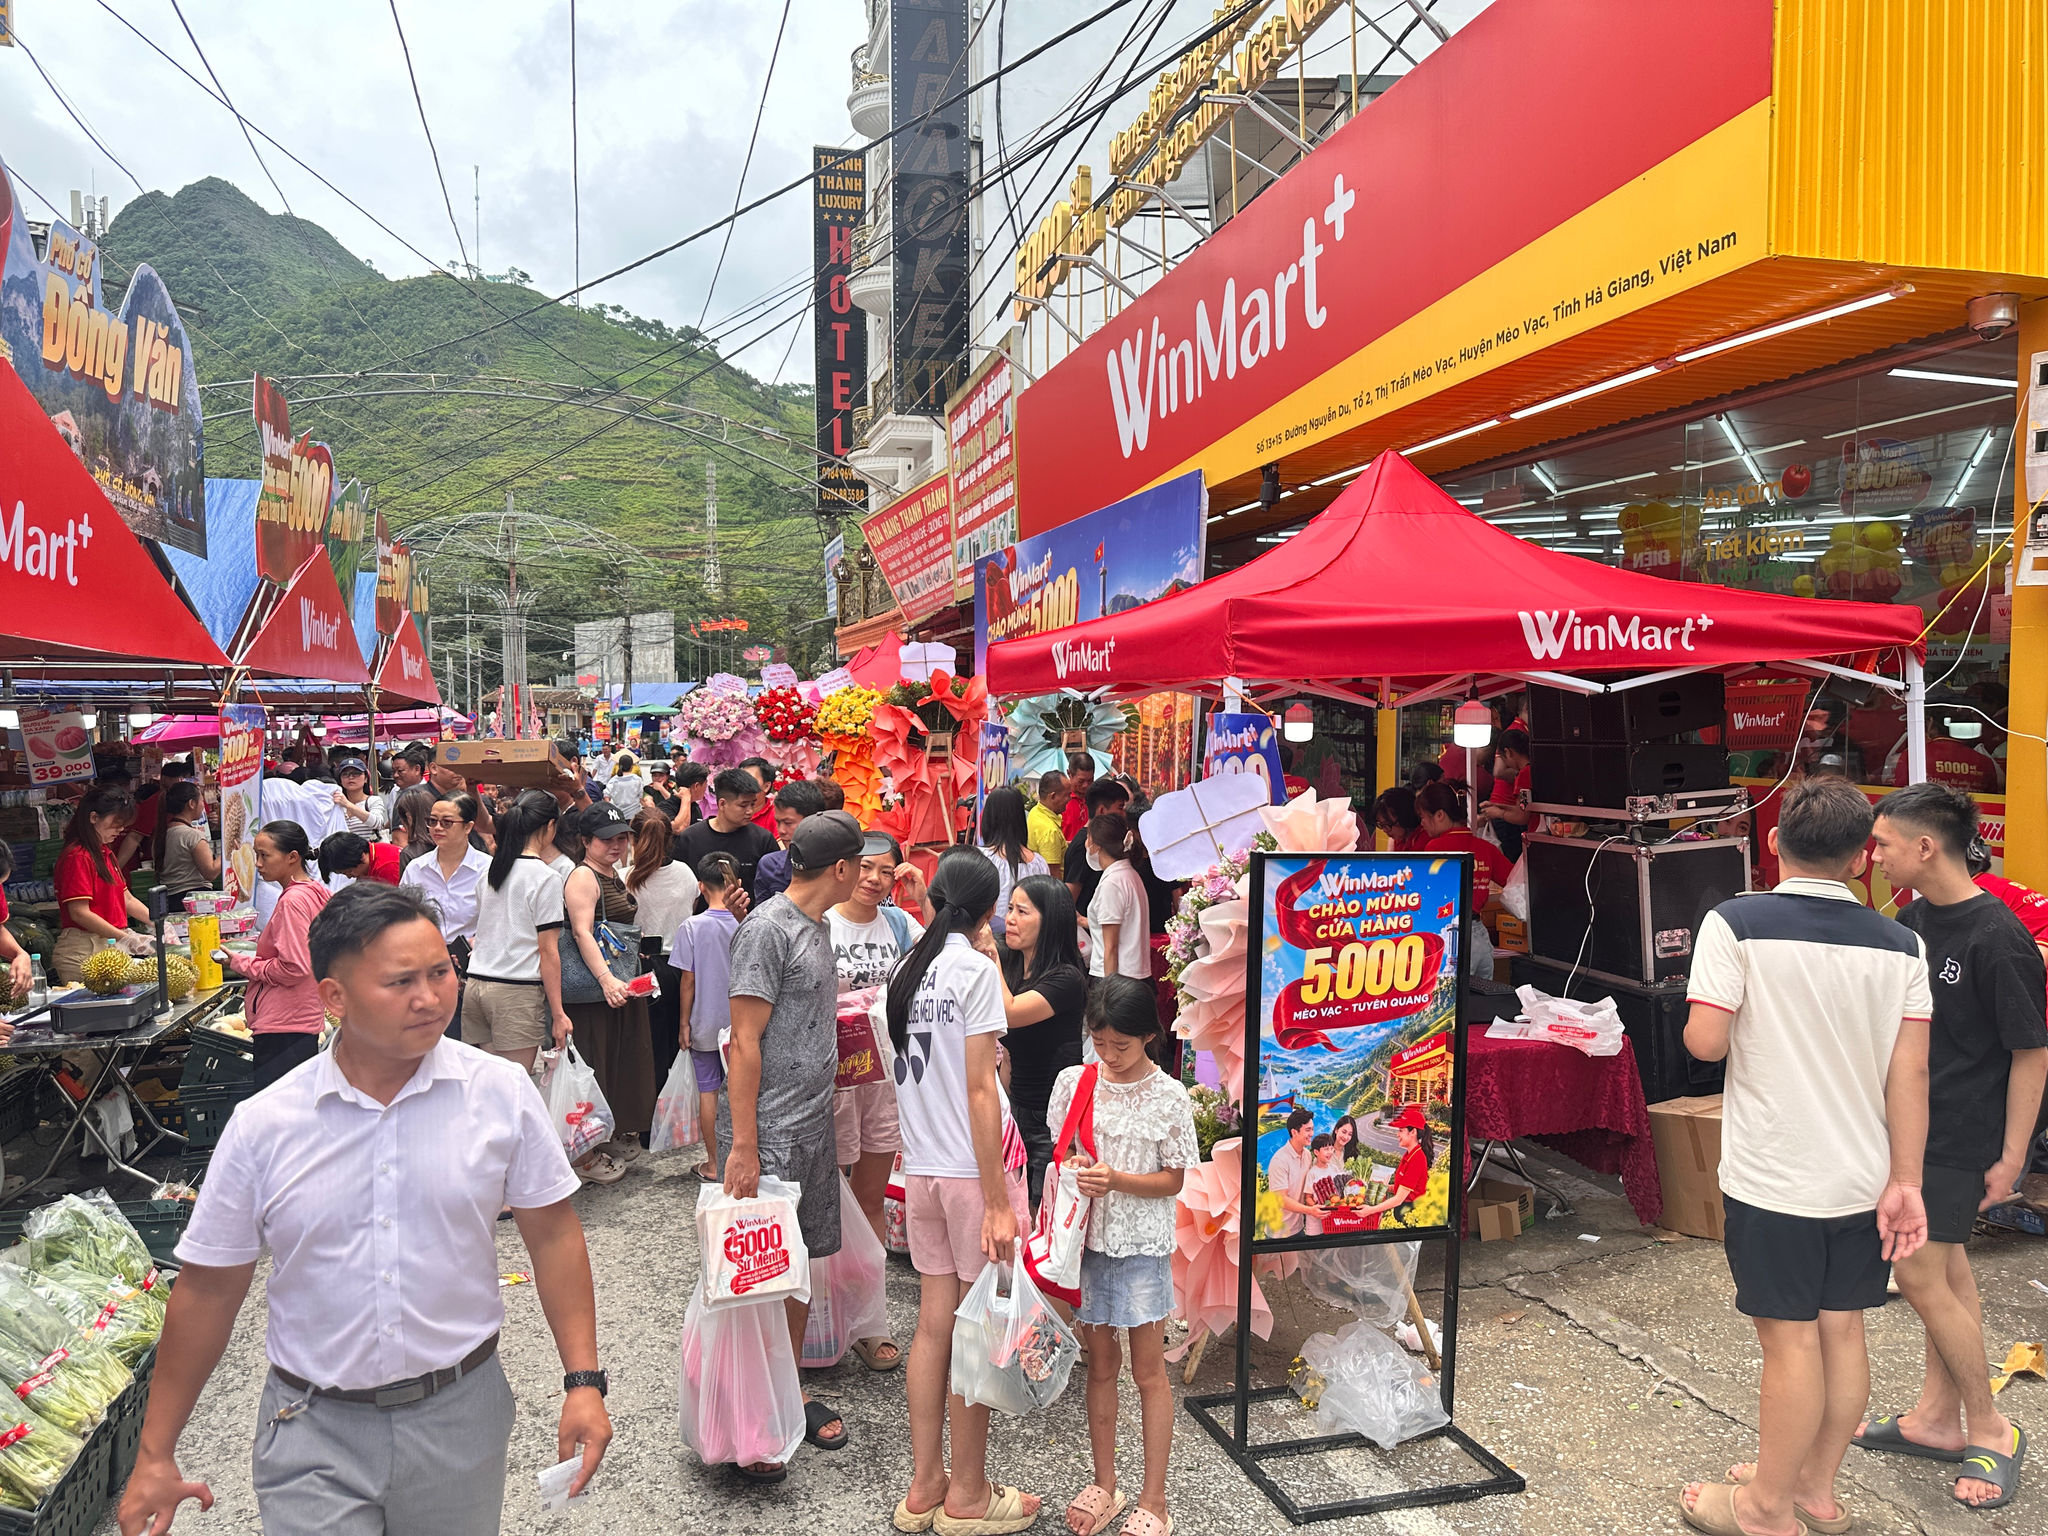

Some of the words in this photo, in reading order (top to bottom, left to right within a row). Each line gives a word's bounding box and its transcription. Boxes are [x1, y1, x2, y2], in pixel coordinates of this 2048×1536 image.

[819, 172, 862, 192] THÀNH
[819, 194, 862, 210] LUXURY
[43, 272, 129, 396] Đồng
[134, 314, 182, 408] Văn
[828, 225, 852, 456] HOTEL
[1256, 437, 1265, 454] Số
[1266, 432, 1282, 451] 13+15
[1284, 422, 1308, 442] Đường
[1308, 406, 1337, 431] Nguyễn
[1338, 403, 1352, 416] Du,
[1353, 390, 1364, 411] Tổ
[1365, 391, 1374, 405] 2,
[1375, 384, 1389, 401] Thị
[1391, 372, 1411, 394] Trấn
[1412, 365, 1433, 384] Mèo
[1435, 355, 1457, 375] Vạc,
[1459, 336, 1493, 363] Huyện
[1496, 327, 1520, 349] Mèo
[1523, 313, 1550, 335] Vạc,
[1553, 297, 1581, 322] Tỉnh
[1585, 287, 1604, 311] Hà
[1607, 268, 1655, 299] Giang,
[1659, 248, 1692, 276] Việt
[1698, 231, 1738, 260] Nam
[288, 455, 331, 533] 5000
[1703, 487, 1733, 514] An
[880, 513, 902, 541] HÀNG
[899, 500, 924, 530] THANH
[922, 485, 947, 517] THÀNH
[987, 614, 1007, 644] CHÀO
[1007, 602, 1030, 632] MỪNG
[34, 762, 92, 781] 39.000
[1935, 761, 1969, 776] 5000
[1308, 897, 1361, 919] CHÀO
[1366, 891, 1421, 912] MỪNG
[1316, 917, 1354, 939] CỬA
[1359, 914, 1412, 935] HÀNG
[1300, 934, 1425, 1005] 5.000
[935, 999, 955, 1027] VẠC
[1293, 1005, 1318, 1021] MÈO
[1321, 1005, 1342, 1019] VẠC
[1351, 997, 1387, 1013] TUYÊN
[1389, 993, 1429, 1008] QUANG
[731, 1223, 783, 1259] 5000
[736, 1257, 752, 1274] Sứ
[753, 1247, 783, 1269] Mệnh
